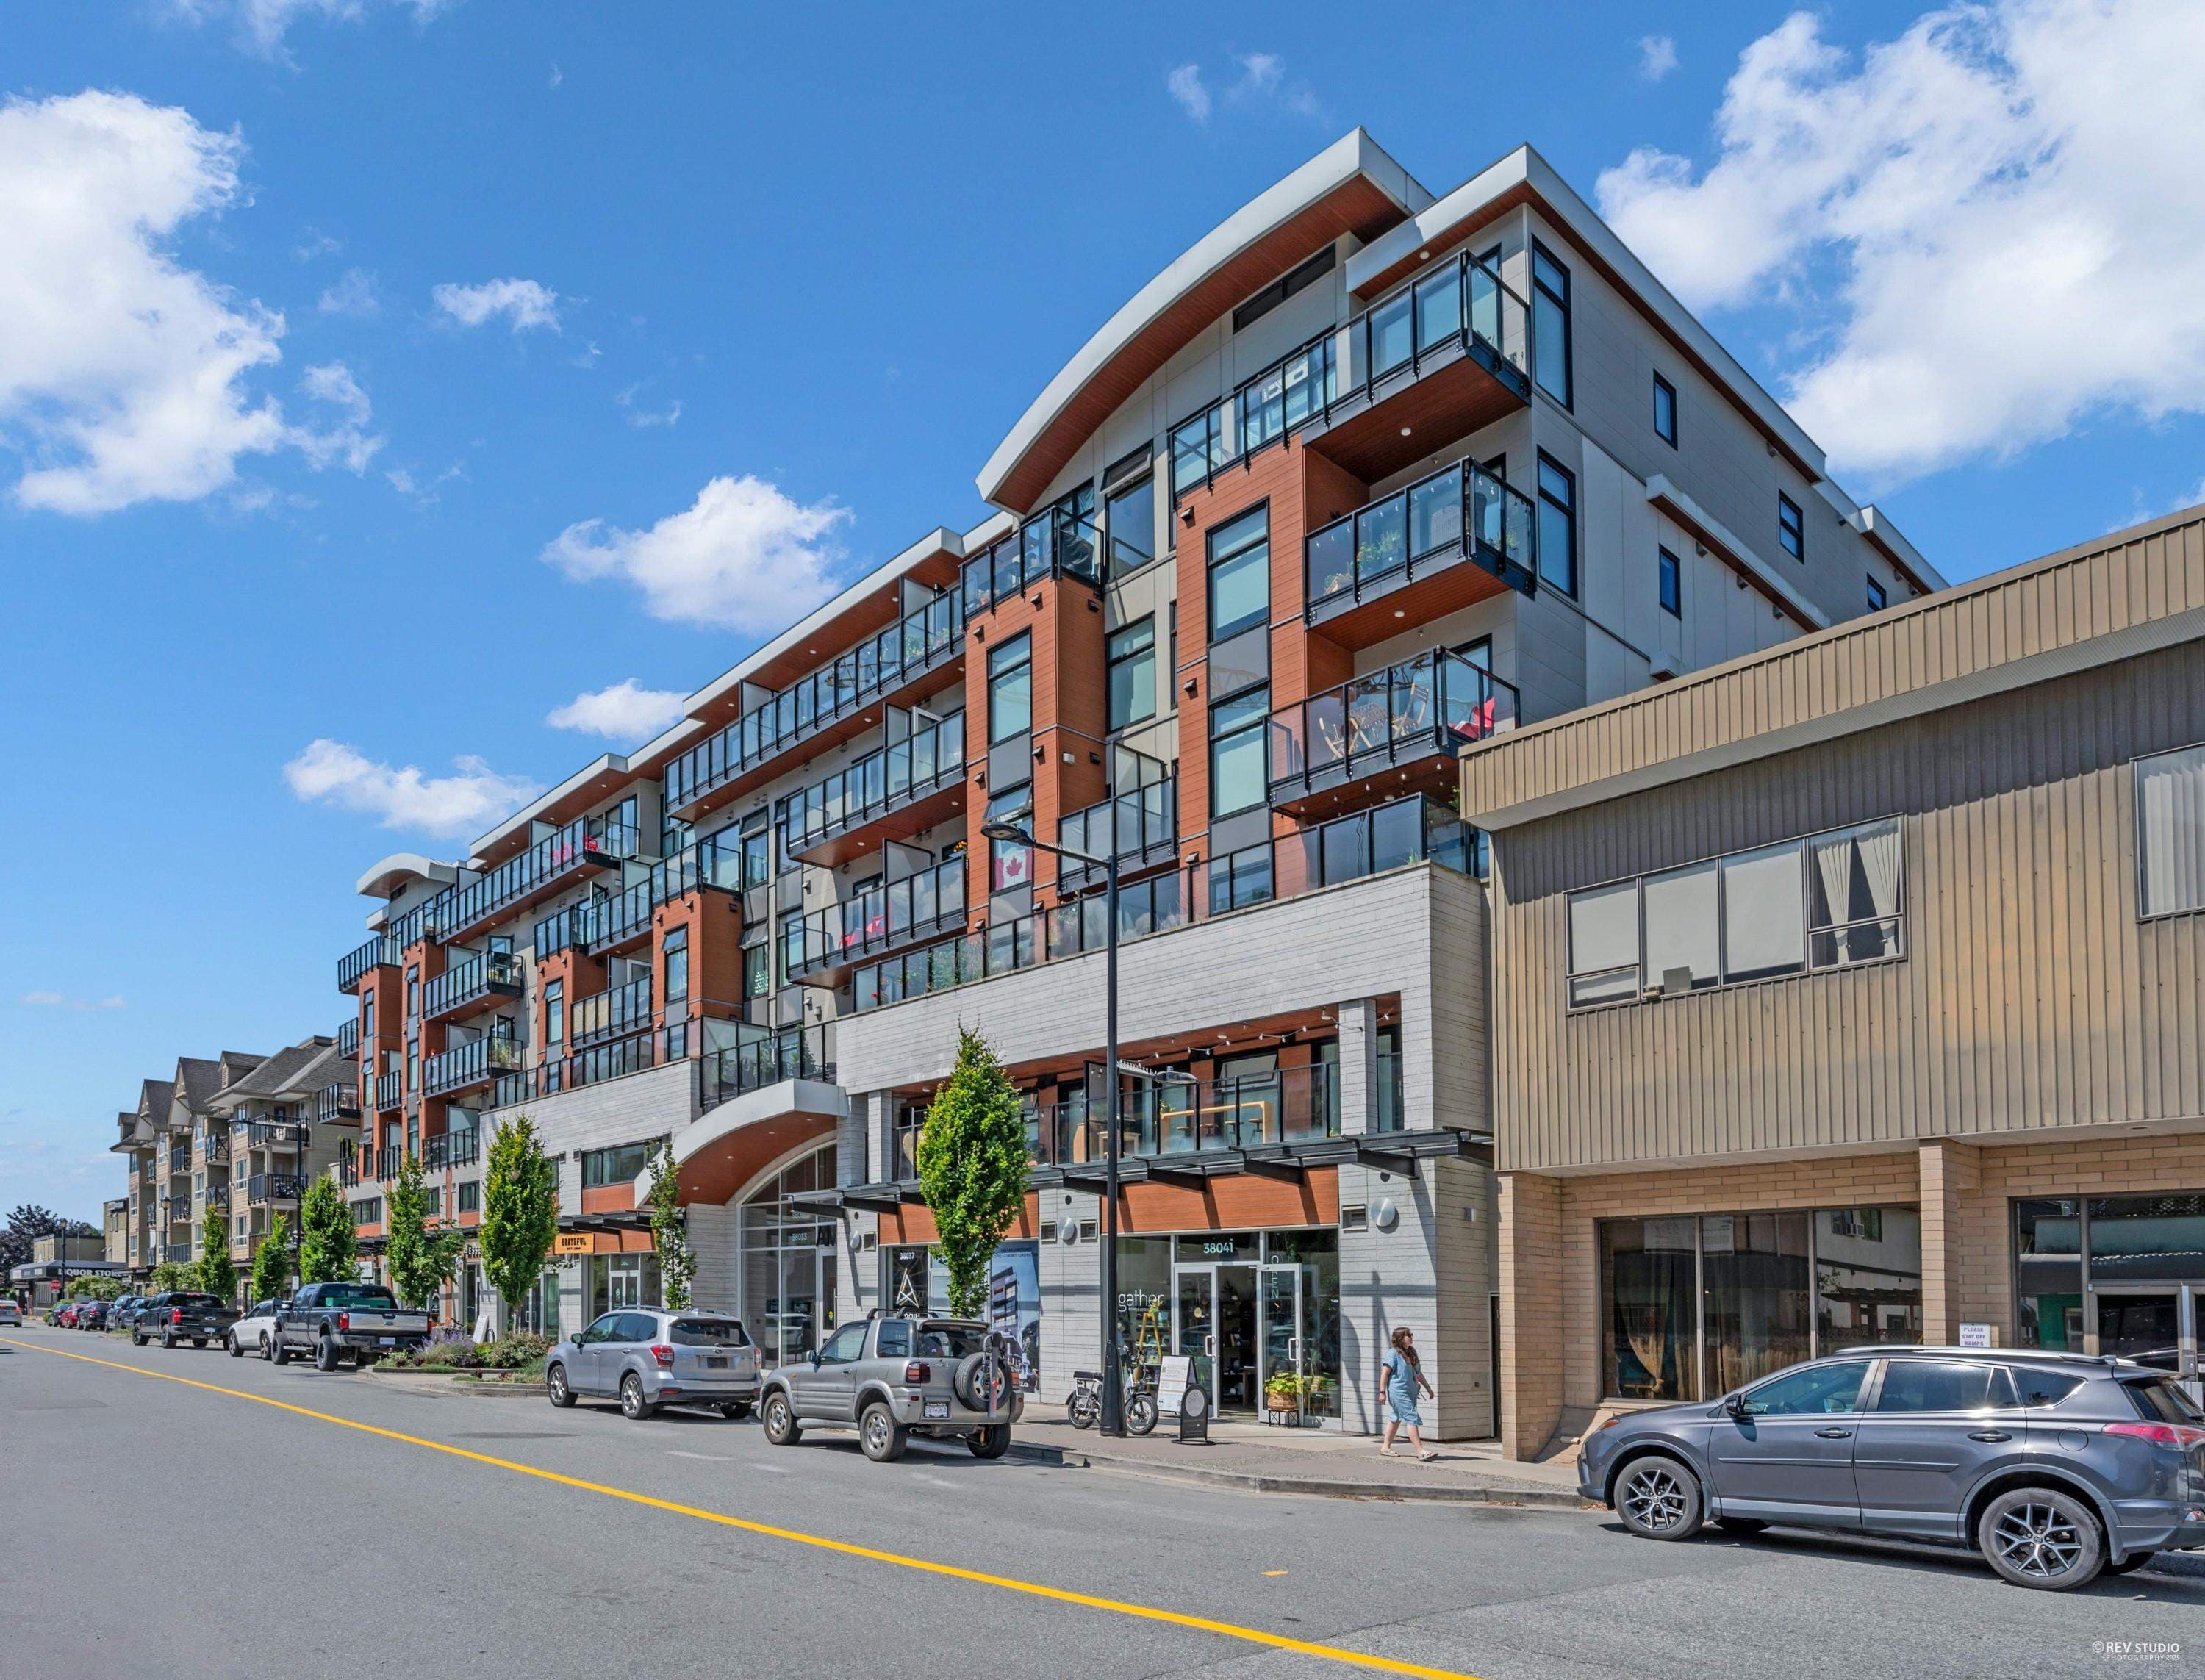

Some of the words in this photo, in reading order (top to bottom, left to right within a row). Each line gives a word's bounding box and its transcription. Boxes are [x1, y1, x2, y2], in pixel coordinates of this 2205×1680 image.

[792, 1233, 807, 1241] 38033
[562, 1238, 587, 1246] GRATEFUL
[1203, 1242, 1233, 1254] 38041
[900, 1252, 915, 1260] 38037
[57, 1268, 93, 1277] LIQUOR
[1118, 1288, 1165, 1312] gather
